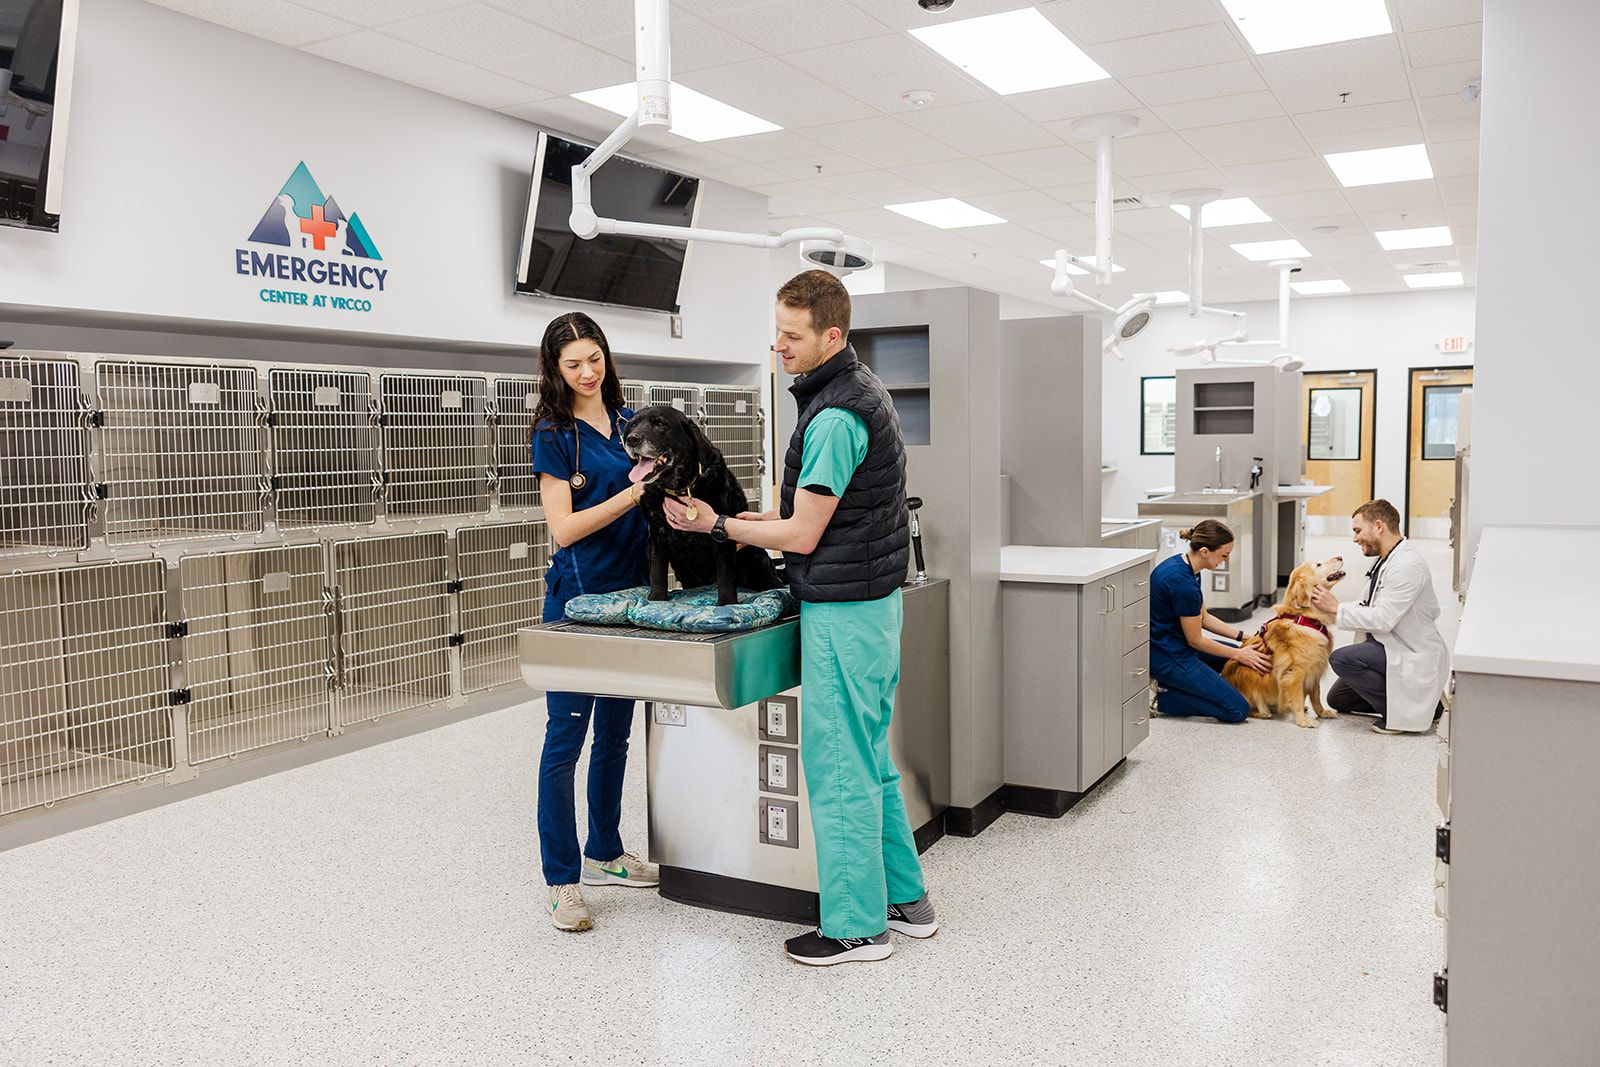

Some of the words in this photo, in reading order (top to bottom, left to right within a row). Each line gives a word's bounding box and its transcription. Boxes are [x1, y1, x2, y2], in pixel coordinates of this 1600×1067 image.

[236, 249, 388, 291] EMERGENCY
[259, 289, 308, 306] CENTER
[312, 295, 327, 307] AT
[330, 297, 372, 312] VRCCO
[1444, 337, 1463, 351] EXIT
